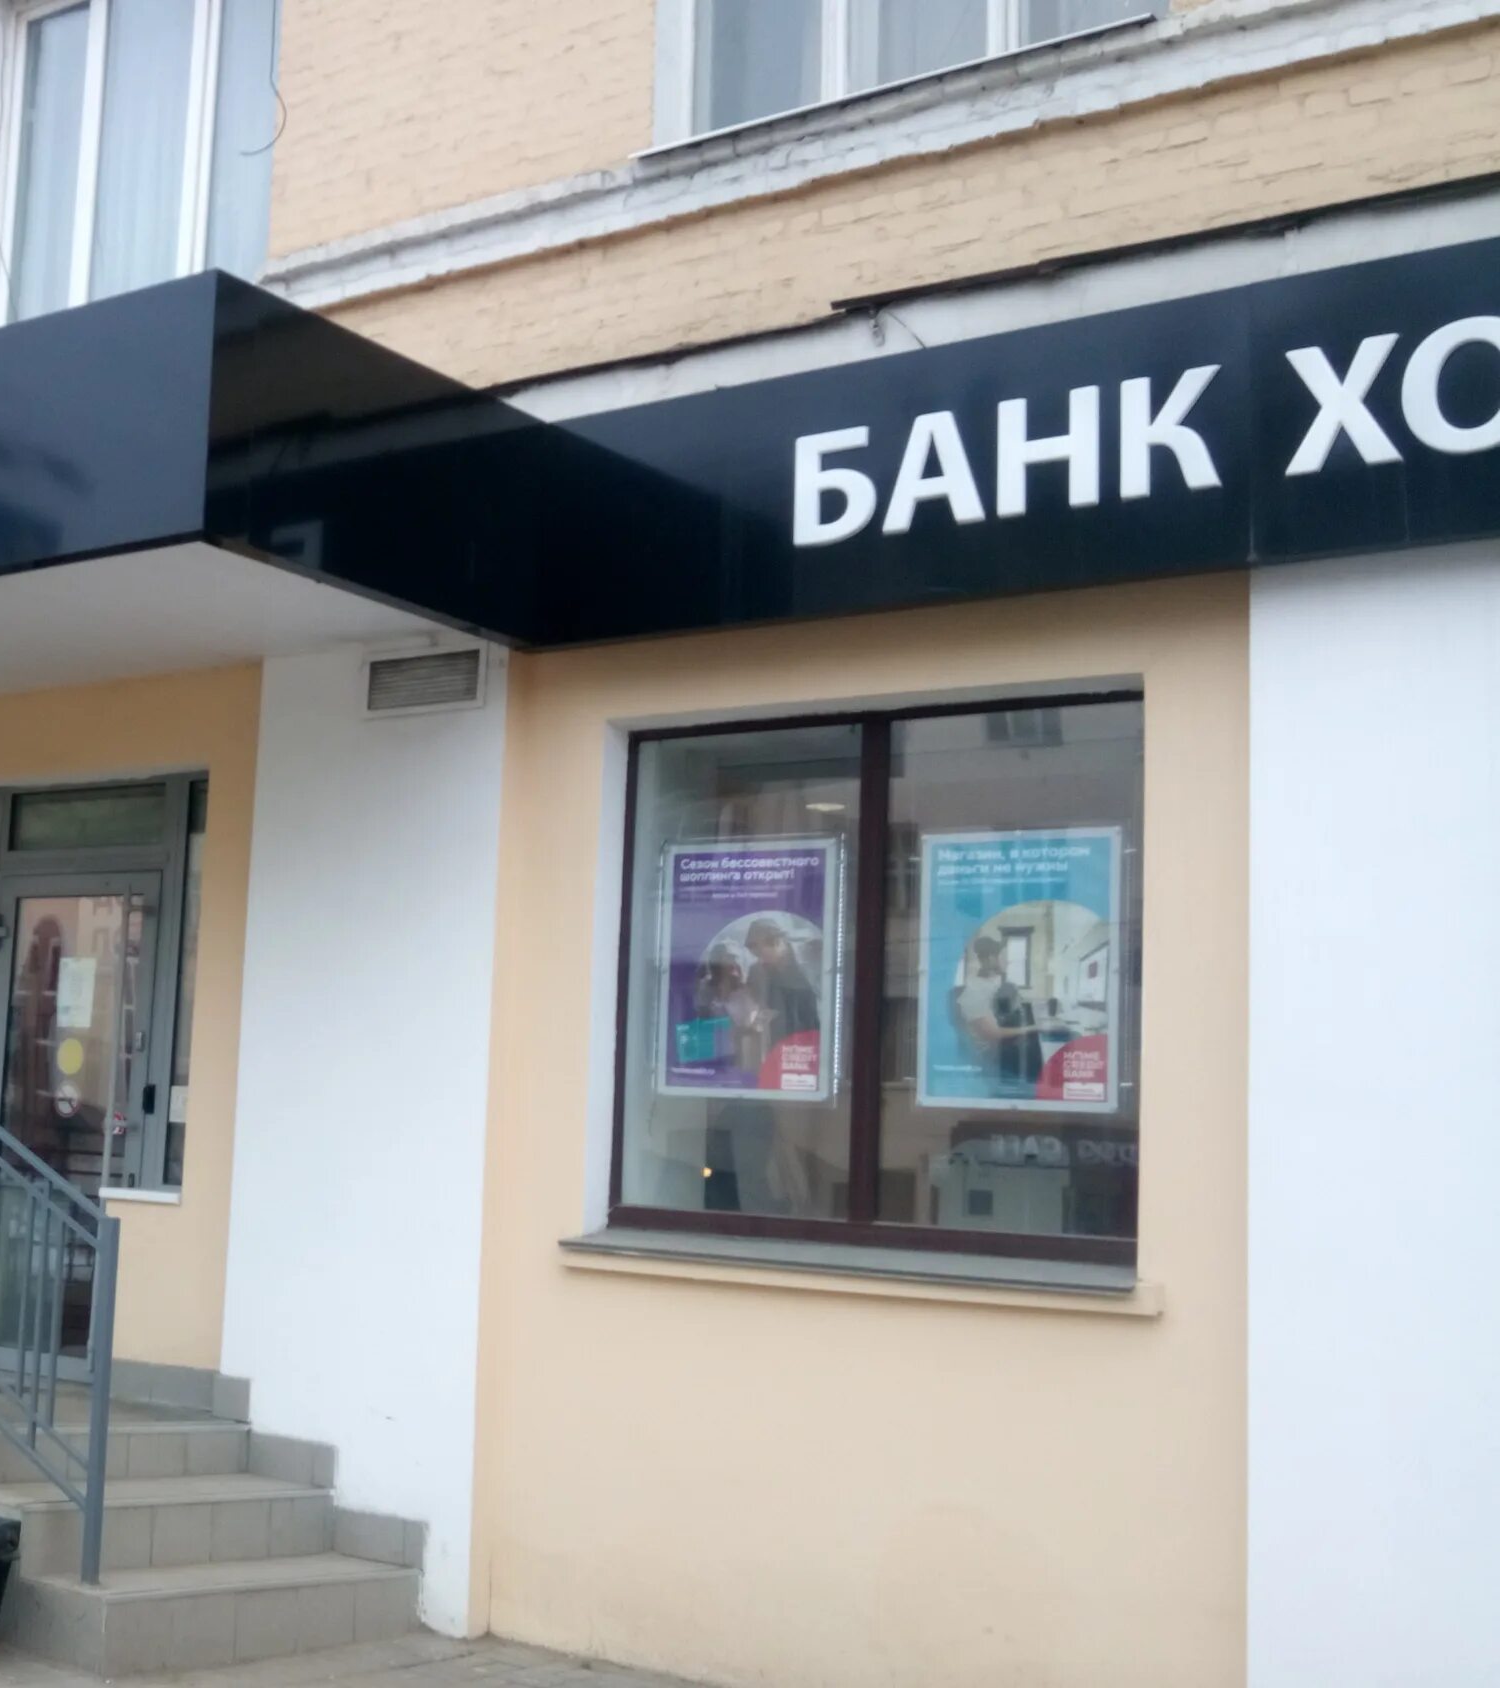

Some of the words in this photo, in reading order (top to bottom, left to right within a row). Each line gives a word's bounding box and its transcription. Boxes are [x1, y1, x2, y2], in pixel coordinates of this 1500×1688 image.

[793, 364, 1222, 547] БАНК
[1284, 314, 1500, 477] ХО
[680, 858, 719, 870] Сезон
[721, 856, 820, 869] бессовестного
[679, 870, 741, 882] шоппинга
[743, 868, 795, 882] открыт!
